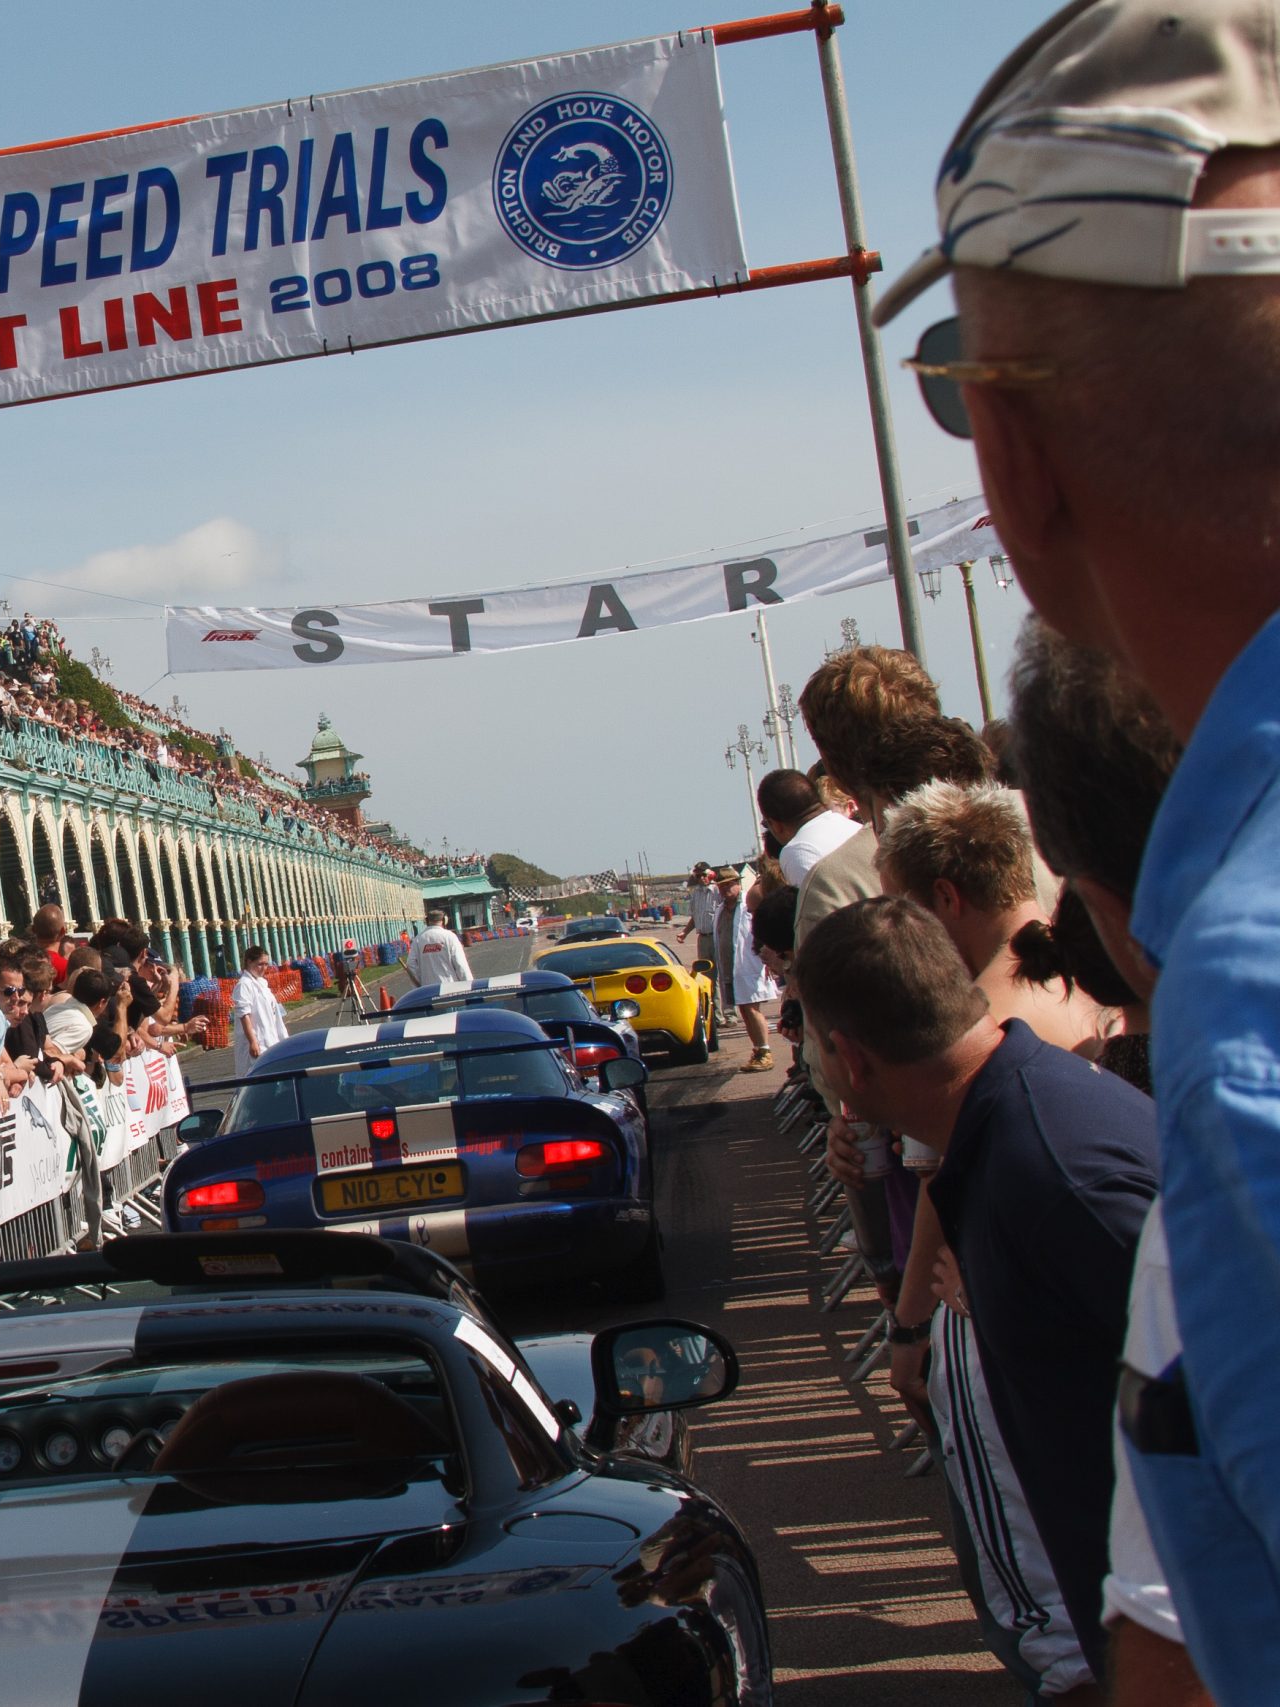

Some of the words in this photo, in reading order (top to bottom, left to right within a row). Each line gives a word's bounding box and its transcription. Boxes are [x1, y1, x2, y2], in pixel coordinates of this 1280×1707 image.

[556, 101, 614, 120] HOVE
[511, 117, 546, 158] AND
[622, 115, 664, 184] MOTOR
[206, 117, 448, 257] TRIALS
[501, 169, 561, 258] BRIGHTON
[621, 197, 660, 245] CLUB
[59, 279, 243, 359] LINE
[269, 252, 442, 315] 2008
[30, 1153, 62, 1191] JAGUAR
[321, 1144, 374, 1169] contains
[395, 1172, 444, 1199] CYL
